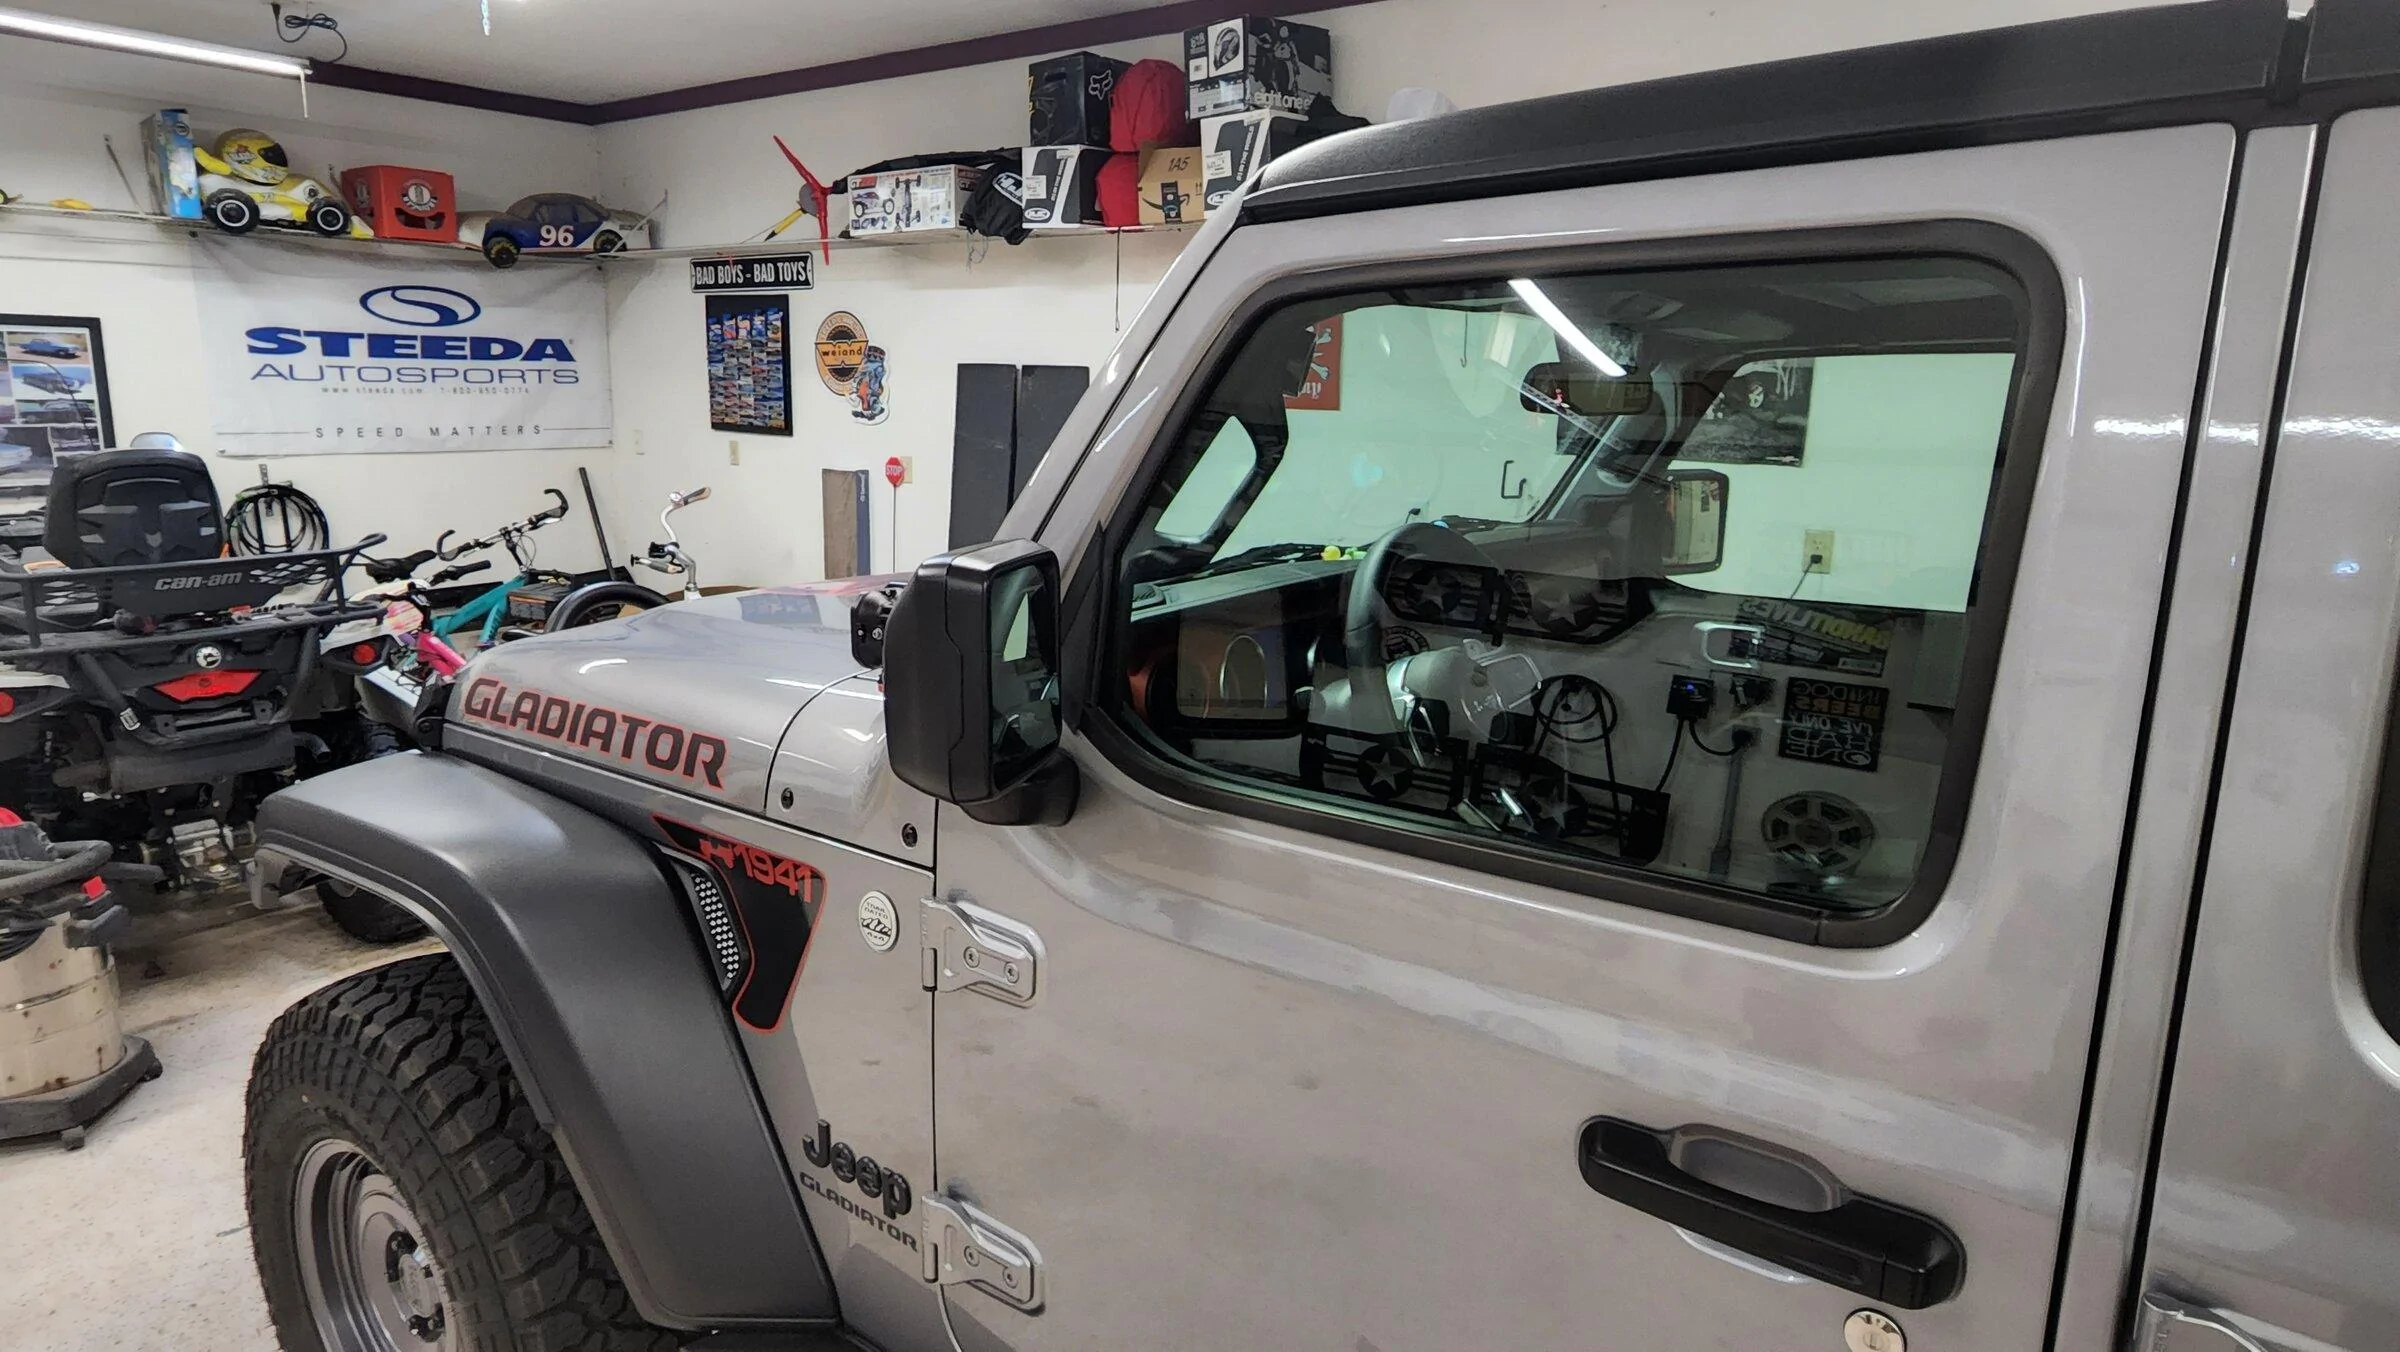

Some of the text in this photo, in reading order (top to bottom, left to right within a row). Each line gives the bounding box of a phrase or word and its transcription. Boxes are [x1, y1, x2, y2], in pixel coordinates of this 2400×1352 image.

[539, 225, 575, 247] 96
[696, 266, 715, 285] BAD
[718, 264, 744, 284] BOYS
[753, 263, 775, 283] BAD
[777, 261, 807, 282] TOYS
[245, 327, 576, 362] STEEDA
[822, 345, 863, 357] weiand
[251, 364, 579, 385] AUTOSPORTS
[316, 424, 541, 438] SPEED MATTERS
[886, 466, 903, 476] STOP
[154, 572, 243, 590] can-am
[464, 677, 727, 790] GLADIATOR
[802, 1119, 912, 1220] Jeep
[800, 1172, 919, 1253] GLADIATOR
